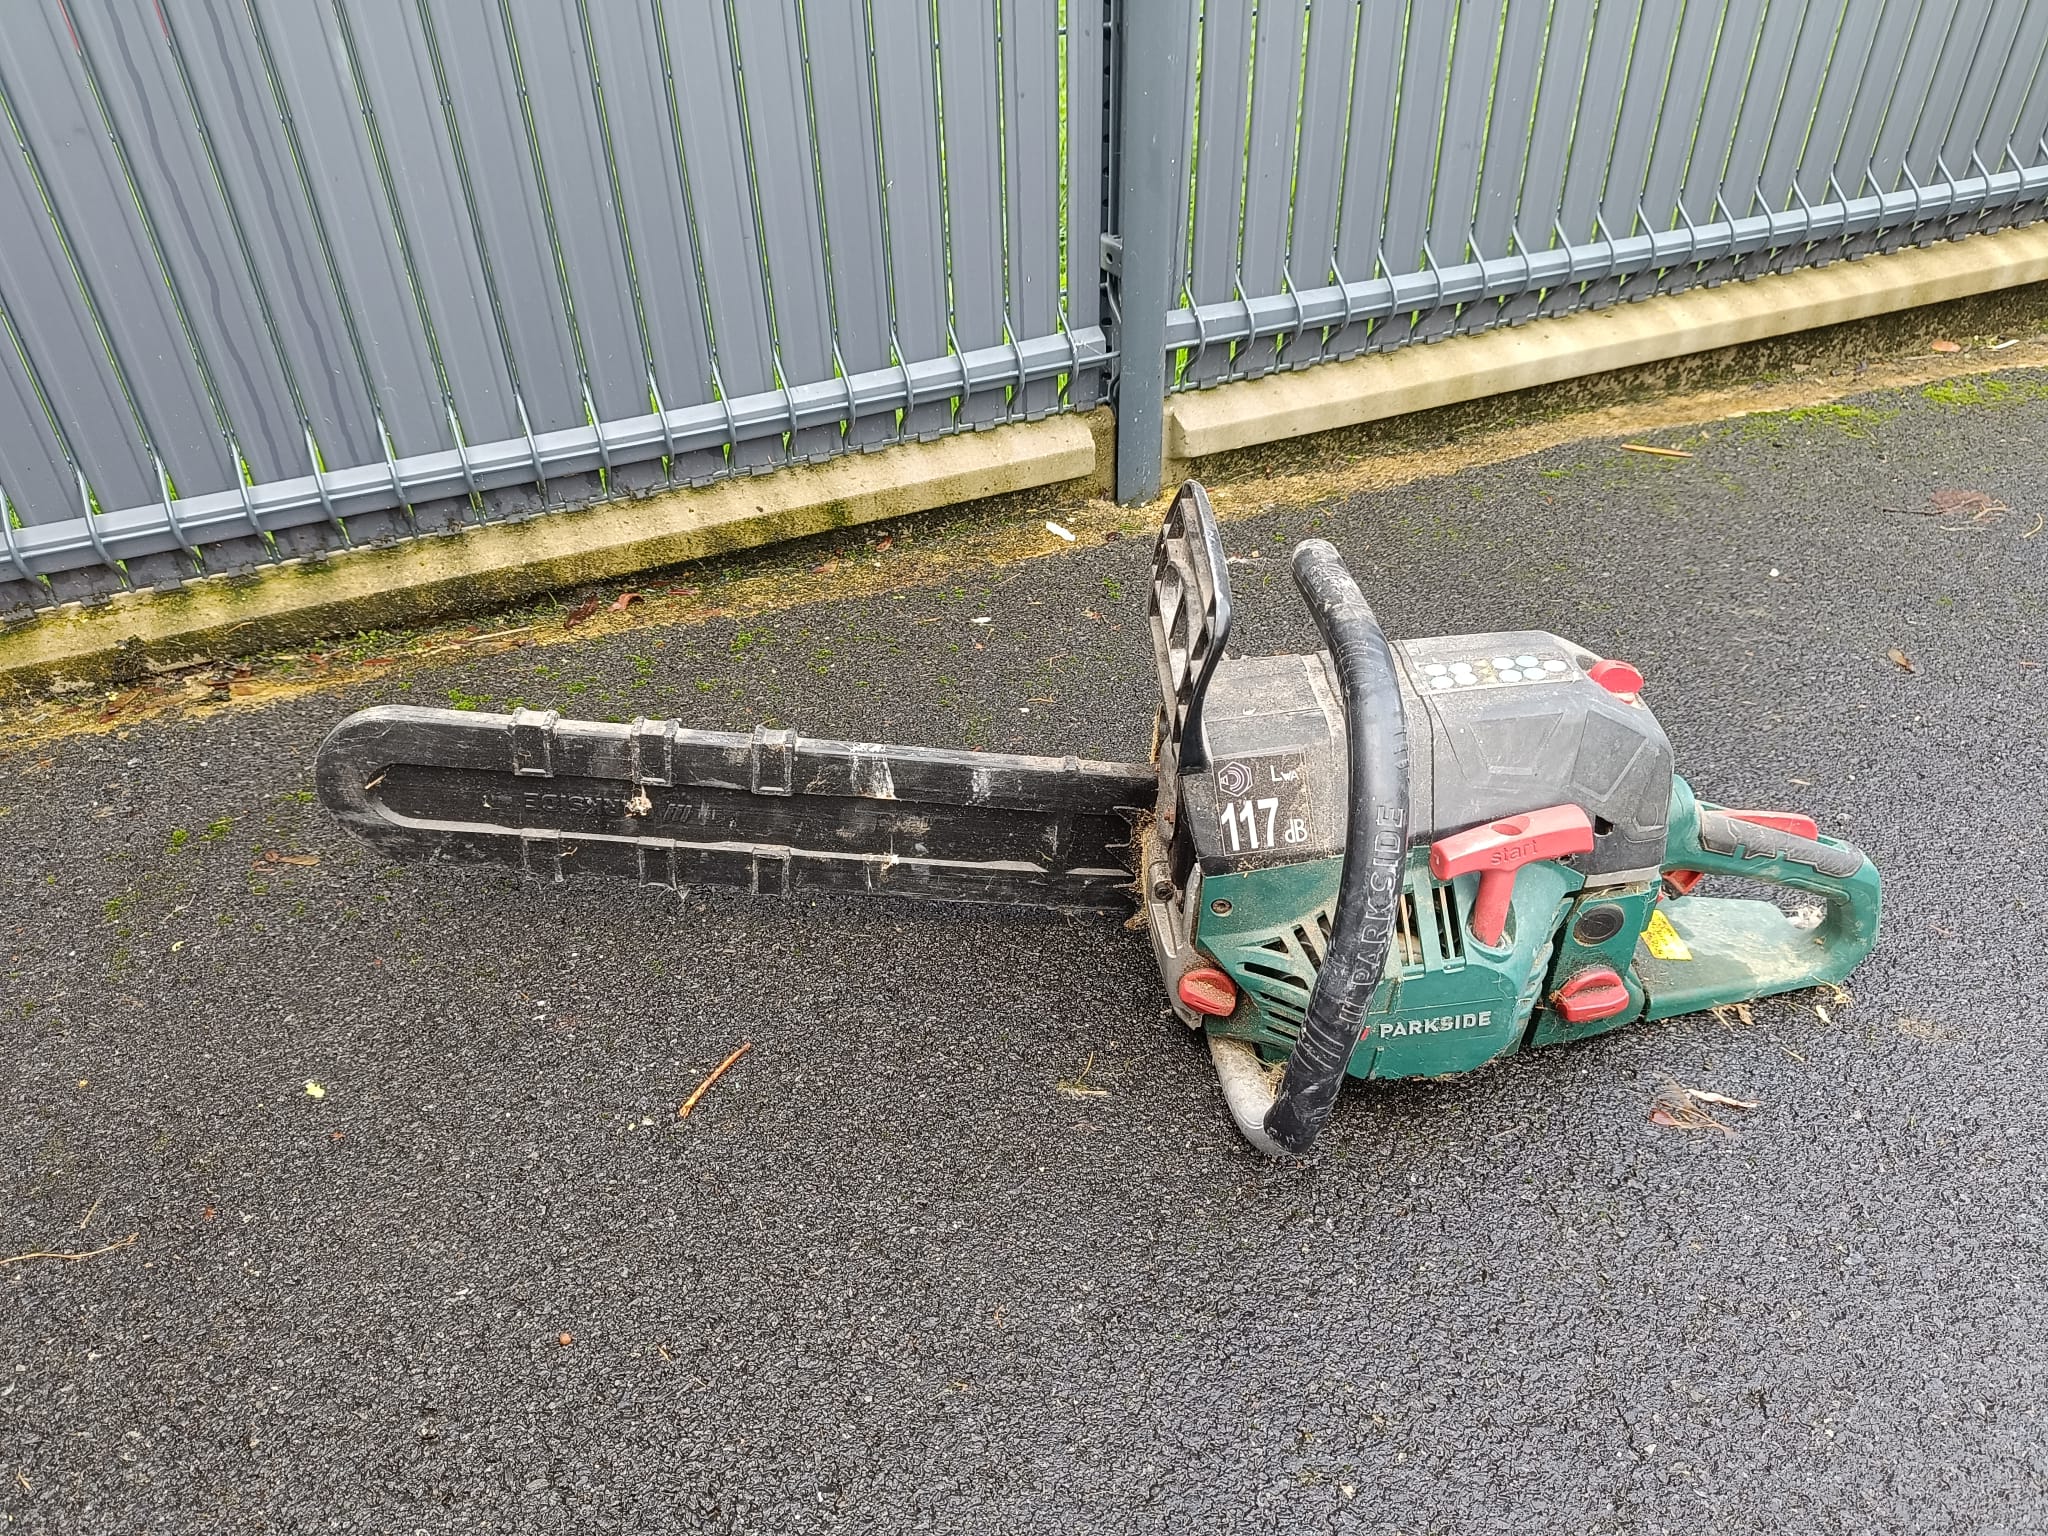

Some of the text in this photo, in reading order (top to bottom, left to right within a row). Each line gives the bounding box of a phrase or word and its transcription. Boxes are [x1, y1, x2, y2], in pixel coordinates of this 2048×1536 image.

[1220, 797, 1308, 852] 117 dB
[1490, 840, 1539, 866] start
[1351, 805, 1405, 987] PARKSIDE
[1379, 1010, 1492, 1039] PARKSIDE
